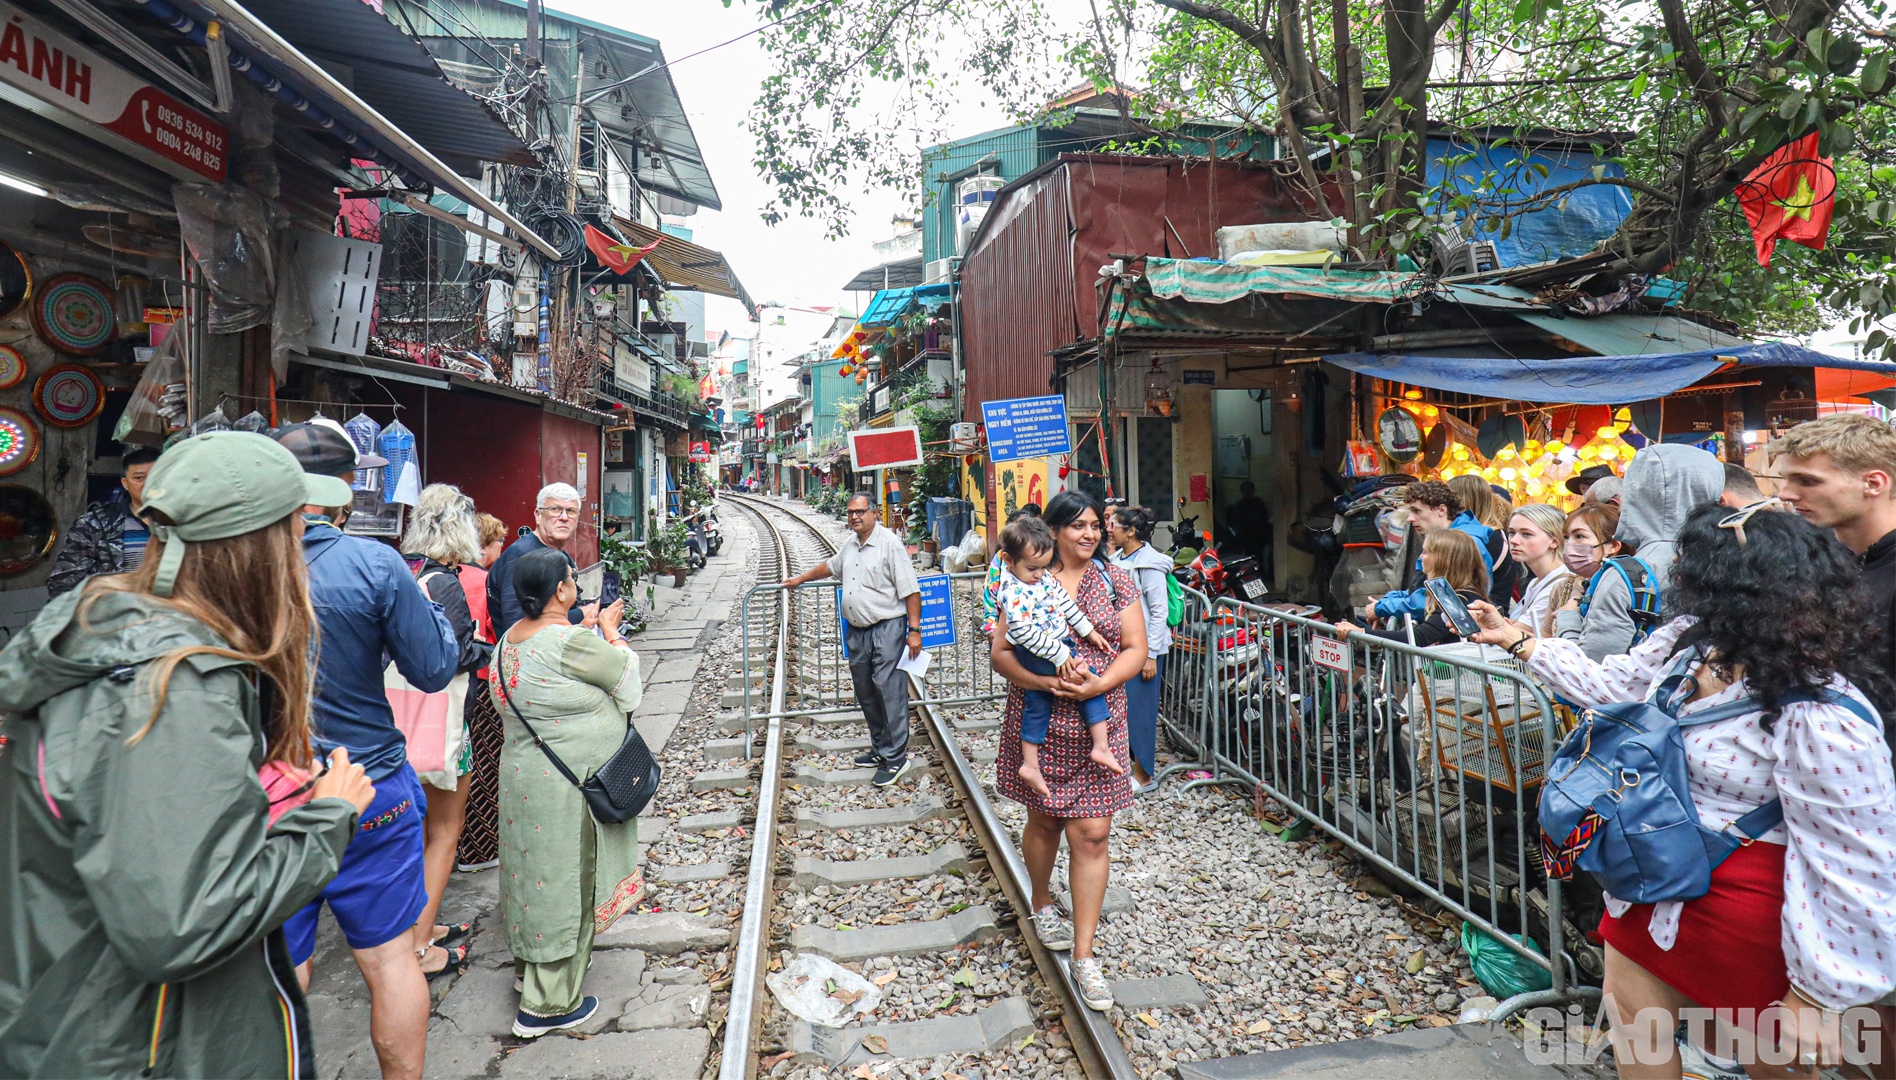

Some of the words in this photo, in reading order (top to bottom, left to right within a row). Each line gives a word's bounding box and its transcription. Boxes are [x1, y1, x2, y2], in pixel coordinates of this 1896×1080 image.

[0, 15, 92, 105] ÁNH
[157, 104, 184, 131] 0936
[185, 122, 204, 142] 534
[205, 130, 223, 151] 912
[156, 126, 182, 153] 0904
[183, 140, 202, 160] 248
[203, 149, 221, 171] 625
[992, 439, 1013, 447] DANGEROUS
[1320, 650, 1341, 663] STOP
[1322, 641, 1337, 649] POLICE
